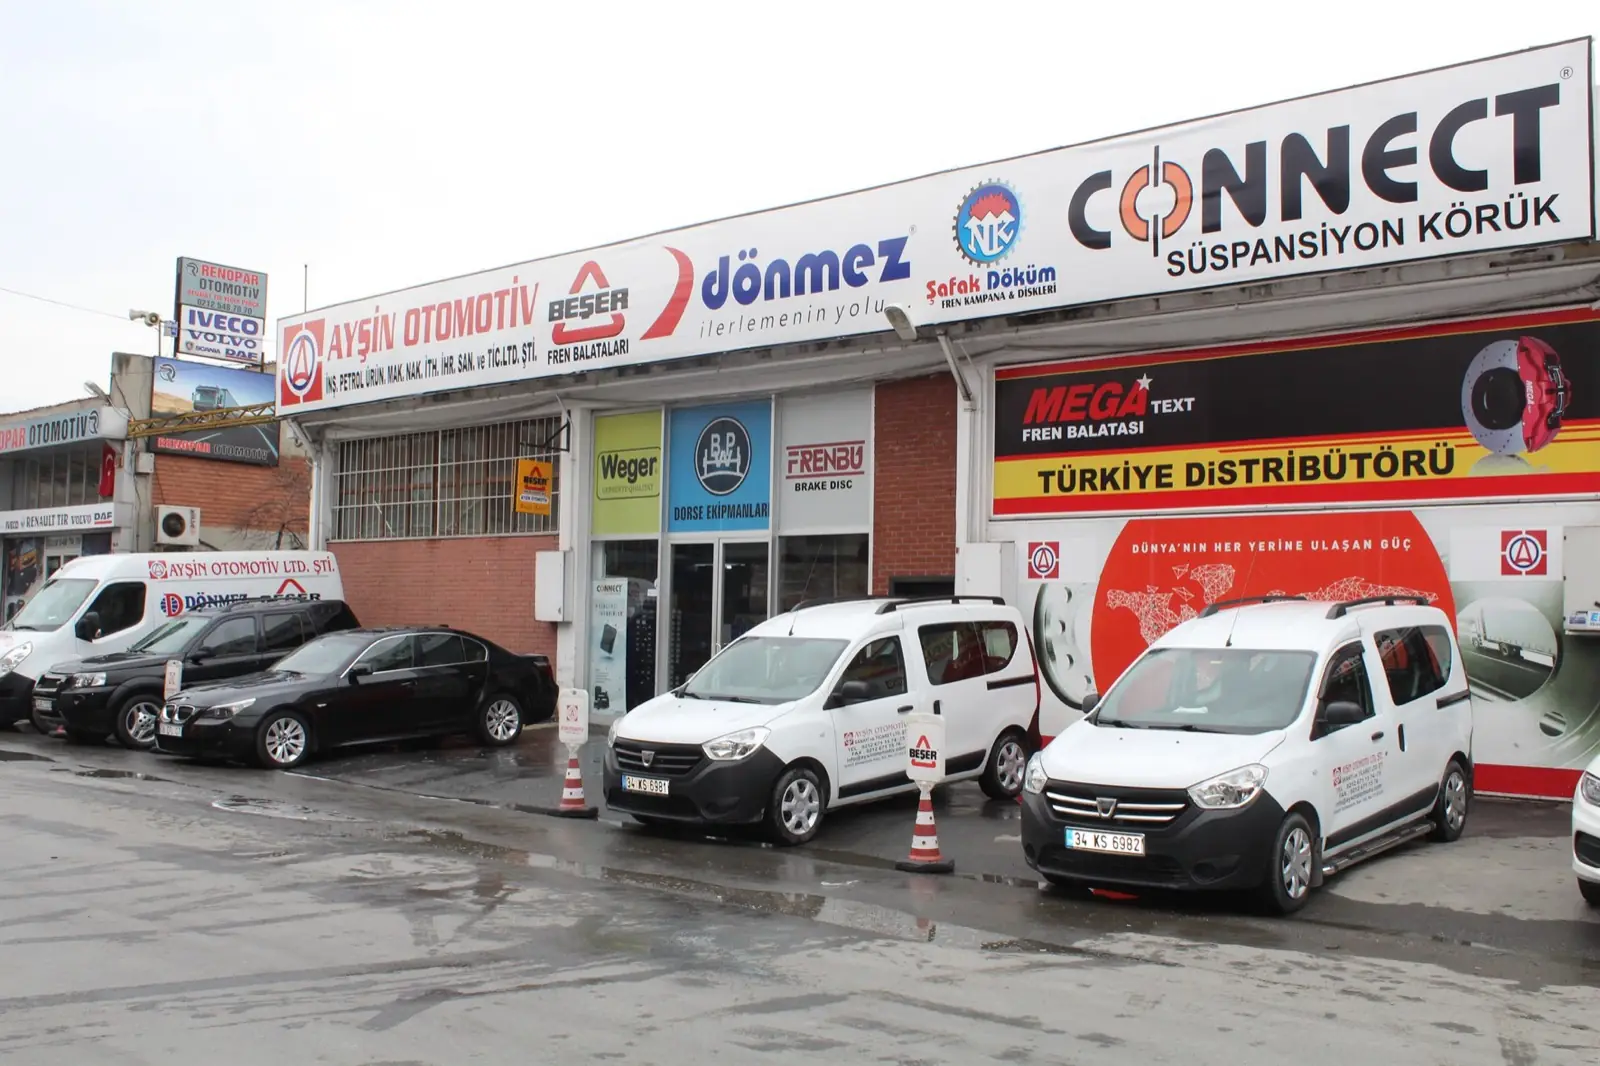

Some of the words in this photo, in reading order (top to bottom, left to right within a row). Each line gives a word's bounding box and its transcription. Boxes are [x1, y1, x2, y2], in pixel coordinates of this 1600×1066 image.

[1068, 82, 1560, 257] CONNECT
[1167, 217, 1405, 278] SÜSPANSİYON
[1418, 191, 1561, 244] KÖRÜK
[201, 264, 259, 286] RENOPAR
[701, 235, 911, 311] dönmez
[926, 274, 981, 305] Şafak
[987, 264, 1056, 290] Döküm
[548, 288, 629, 323] BEŞER
[941, 296, 962, 309] FREN
[964, 291, 1006, 306] KAMPANA
[1008, 290, 1015, 300] &
[1017, 282, 1057, 299] DİSKLERİ
[188, 309, 259, 336] IVECO
[327, 305, 397, 364] AYŞİN
[403, 275, 539, 347] OTOMOTİV
[699, 307, 827, 339] ilerlemenin
[188, 329, 257, 349] VOLVO
[195, 345, 221, 354] SCANIA
[225, 348, 258, 360] DAF
[547, 347, 571, 365] FREN
[572, 338, 630, 361] BALATALARI
[339, 370, 364, 393] PETROL
[366, 363, 386, 389] ÜRÜN.
[387, 364, 404, 384] MAK.
[405, 361, 423, 382] NAK.
[457, 351, 475, 374] SAN.
[476, 355, 486, 371] ve
[1022, 380, 1150, 425] MEGA
[1151, 398, 1196, 414] TEXT
[28, 413, 88, 446] OTOMOTİV
[1022, 427, 1062, 442] FREN
[1067, 421, 1144, 440] BALATASI
[601, 453, 657, 484] Weger
[1037, 461, 1175, 494] TÜRKİYE
[794, 481, 827, 492] BRAKE
[830, 480, 853, 491] DISC
[26, 513, 56, 528] RENAULT
[57, 513, 69, 526] TIR
[94, 511, 112, 522] DAF
[674, 505, 703, 521] DORSE
[1132, 541, 1207, 554] DÜNYA'NIN
[1214, 541, 1241, 552] HER
[1249, 538, 1303, 552] YERİNE
[1310, 539, 1373, 553] ULAŞAN
[1380, 536, 1412, 551] GÜÇ
[169, 559, 208, 581] AYŞİN
[211, 555, 279, 576] OTOMOTİV
[283, 558, 310, 574] LTD.
[313, 555, 335, 577] ŞTİ.
[909, 748, 937, 761] BEŞER
[1074, 832, 1087, 846] 34
[1093, 834, 1107, 848] KS
[1112, 836, 1140, 851] 6982
